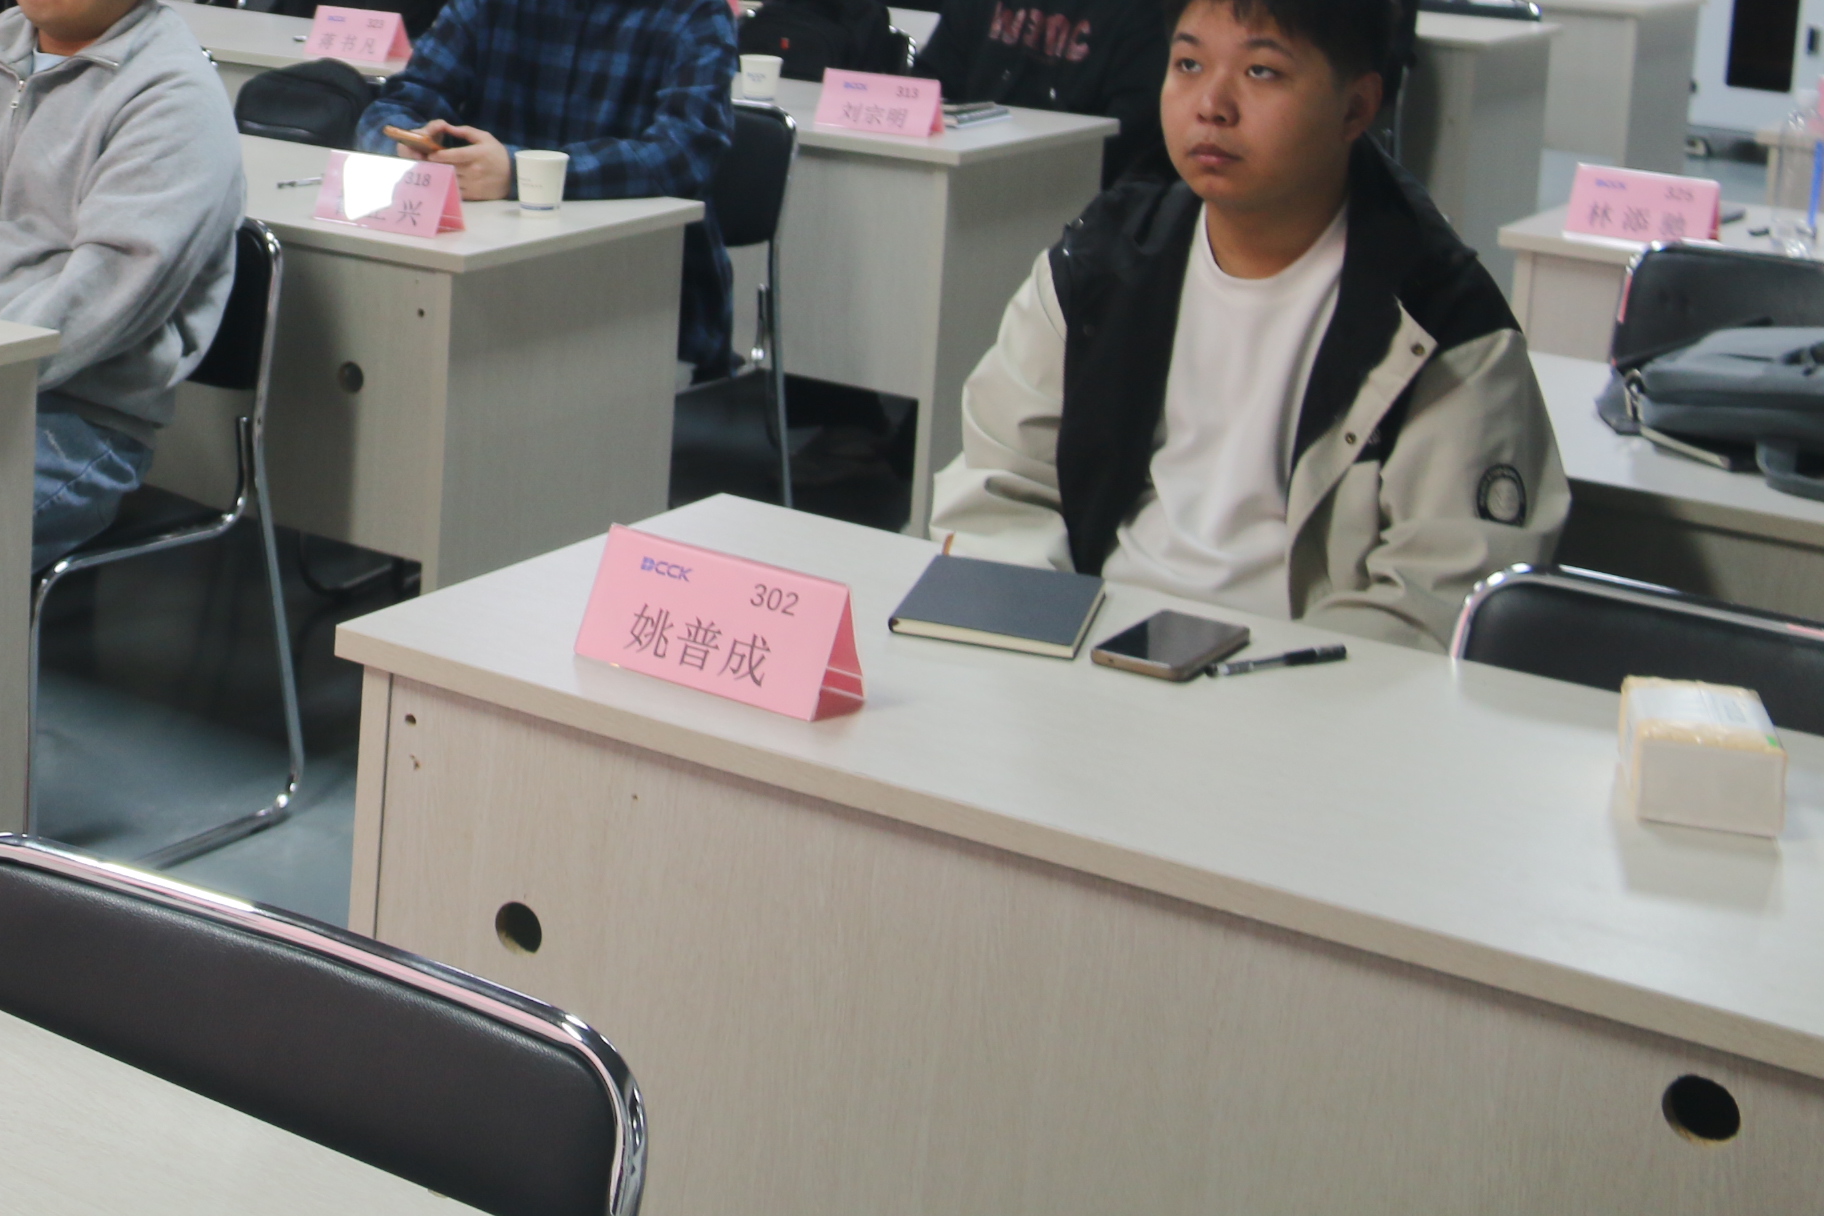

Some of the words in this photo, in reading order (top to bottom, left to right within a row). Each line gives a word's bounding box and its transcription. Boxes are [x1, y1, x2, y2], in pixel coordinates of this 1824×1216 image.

[896, 85, 919, 99] 313
[405, 171, 432, 187] 318
[640, 556, 694, 582] DCCK
[750, 583, 800, 617] 302
[624, 603, 772, 688] 姚普成
